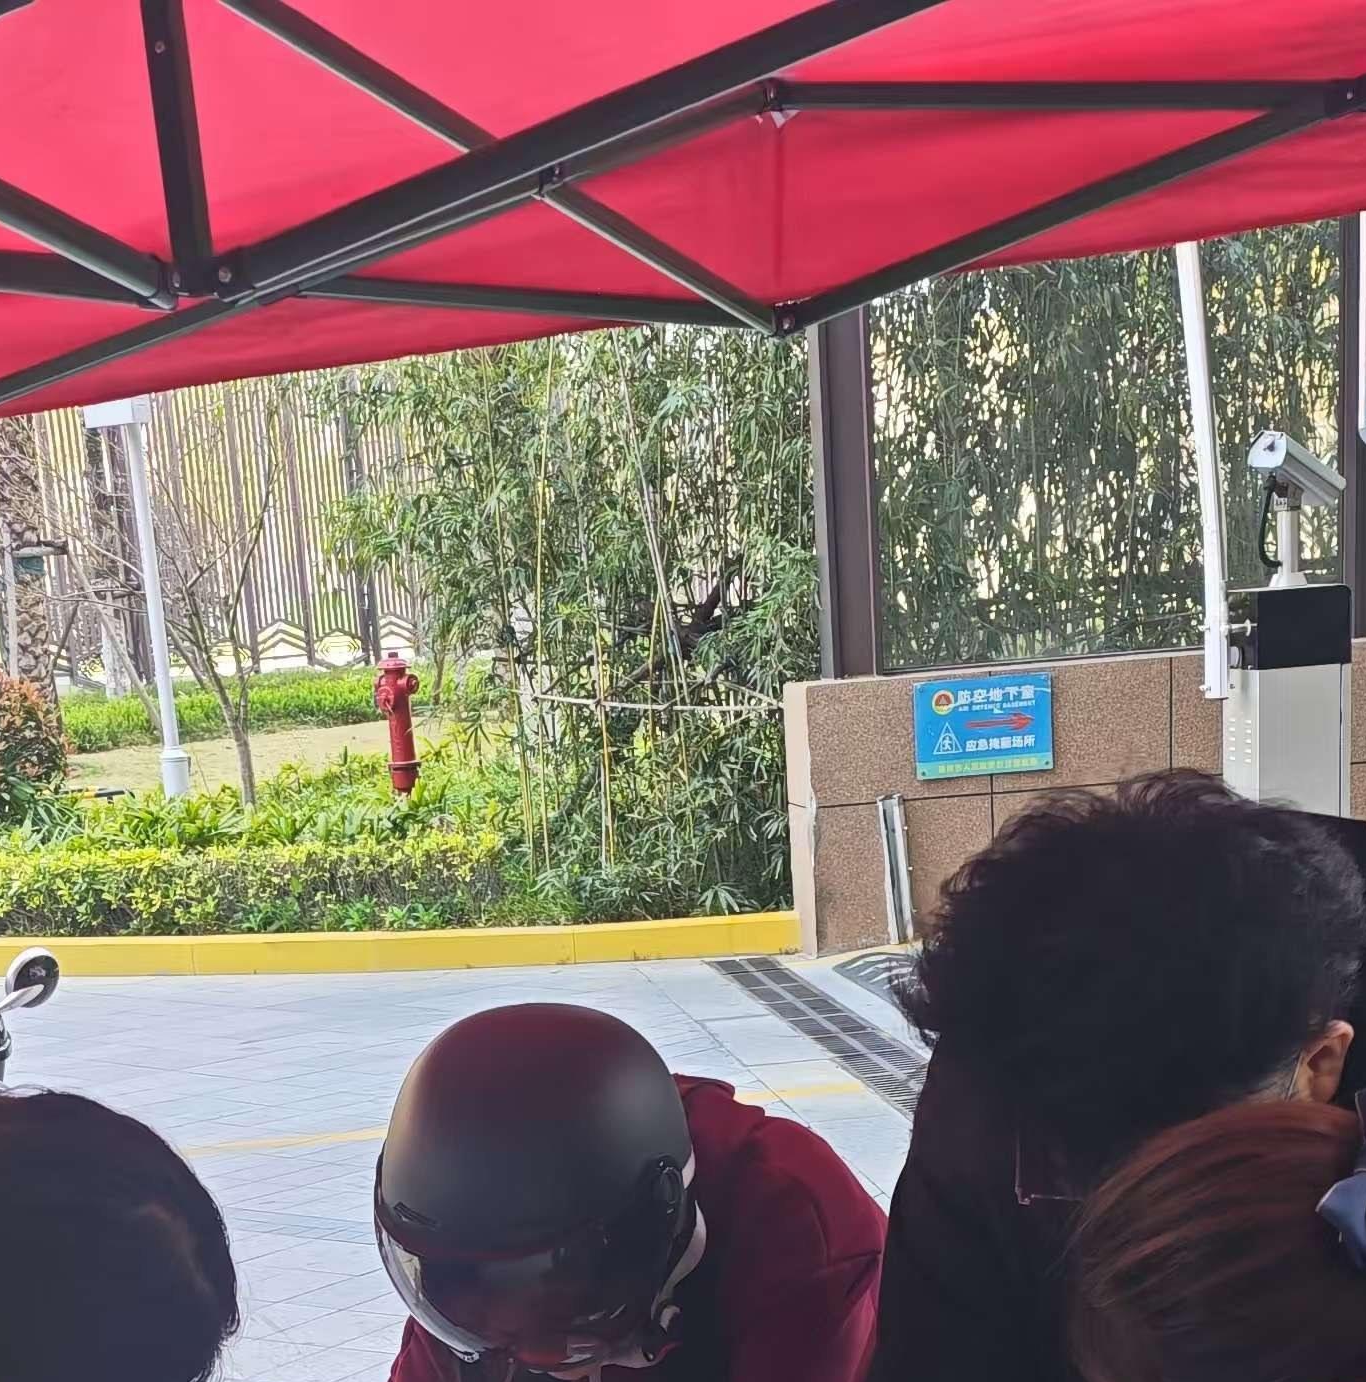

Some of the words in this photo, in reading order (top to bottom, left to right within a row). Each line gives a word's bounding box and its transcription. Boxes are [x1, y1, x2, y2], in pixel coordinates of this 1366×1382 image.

[957, 685, 1035, 705] 防空地下室
